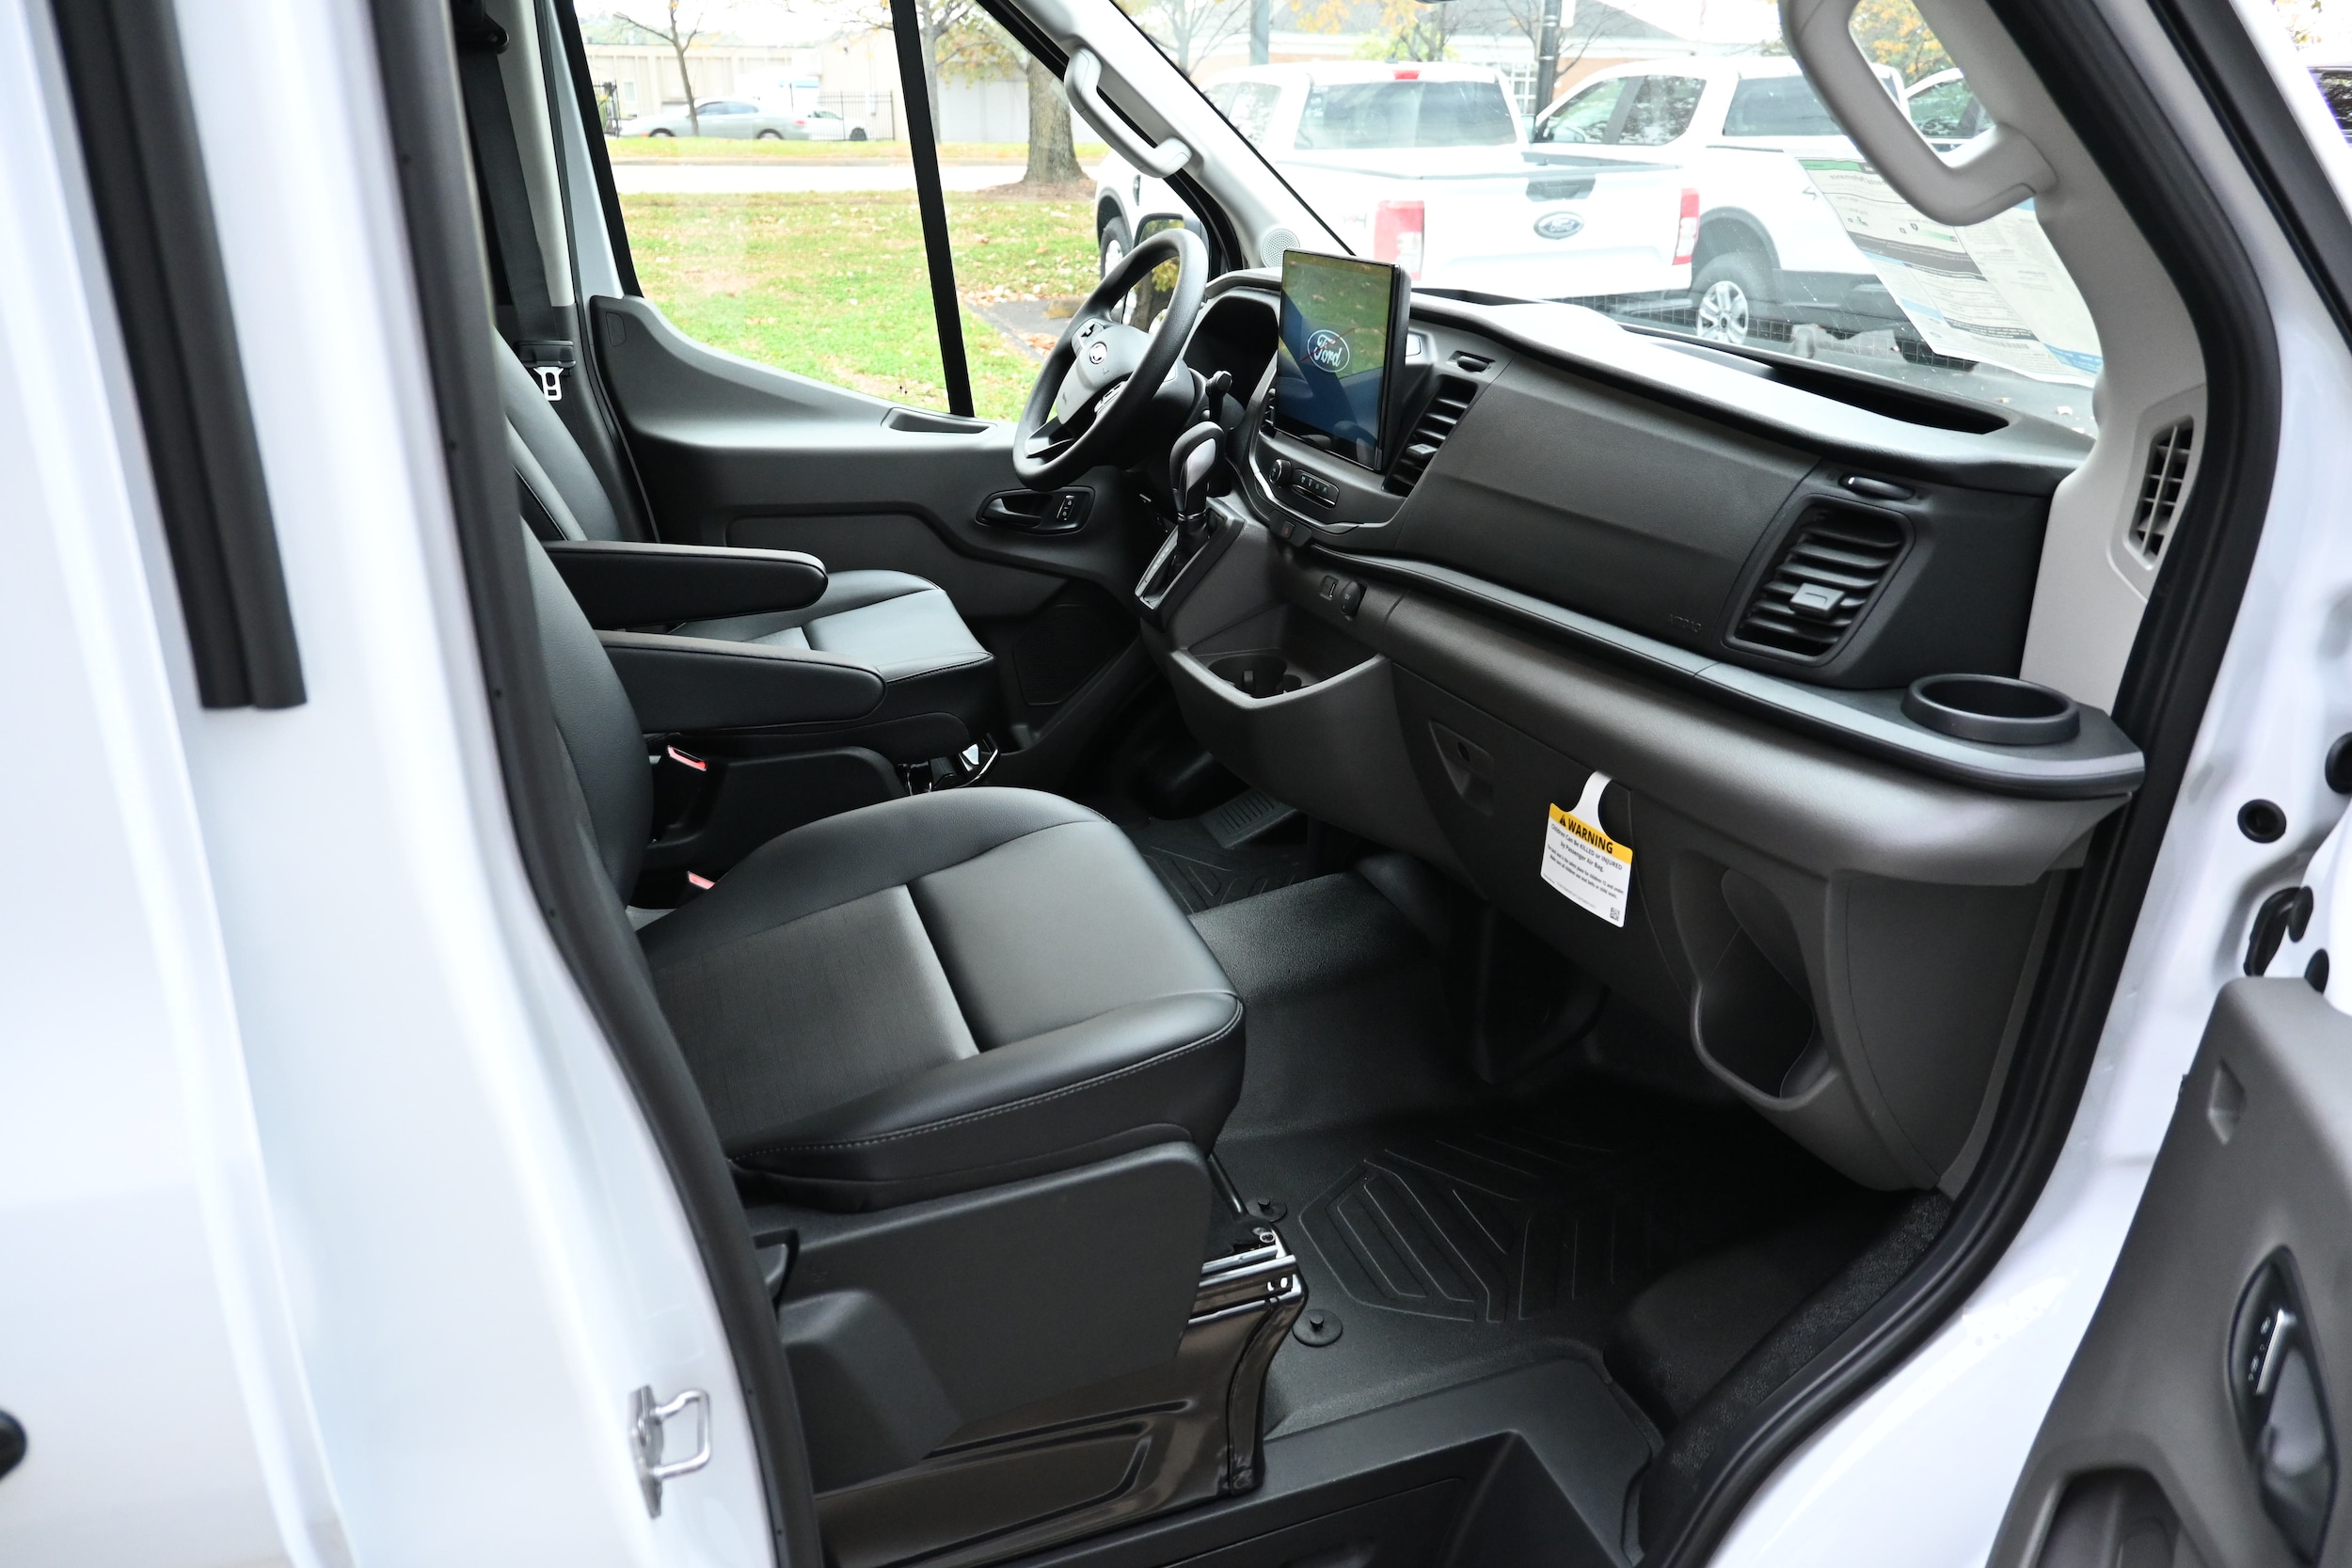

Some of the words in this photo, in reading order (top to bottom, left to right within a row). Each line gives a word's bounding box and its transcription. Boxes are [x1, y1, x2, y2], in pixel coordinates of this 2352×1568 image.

[1313, 334, 1343, 368] Ford
[1550, 824, 1565, 838] Children
[1580, 844, 1594, 856] KILLED
[1601, 855, 1622, 870] INJURED
[1560, 841, 1565, 849] by
[1565, 845, 1586, 863] Passenger
[1566, 818, 1613, 854] WARNING
